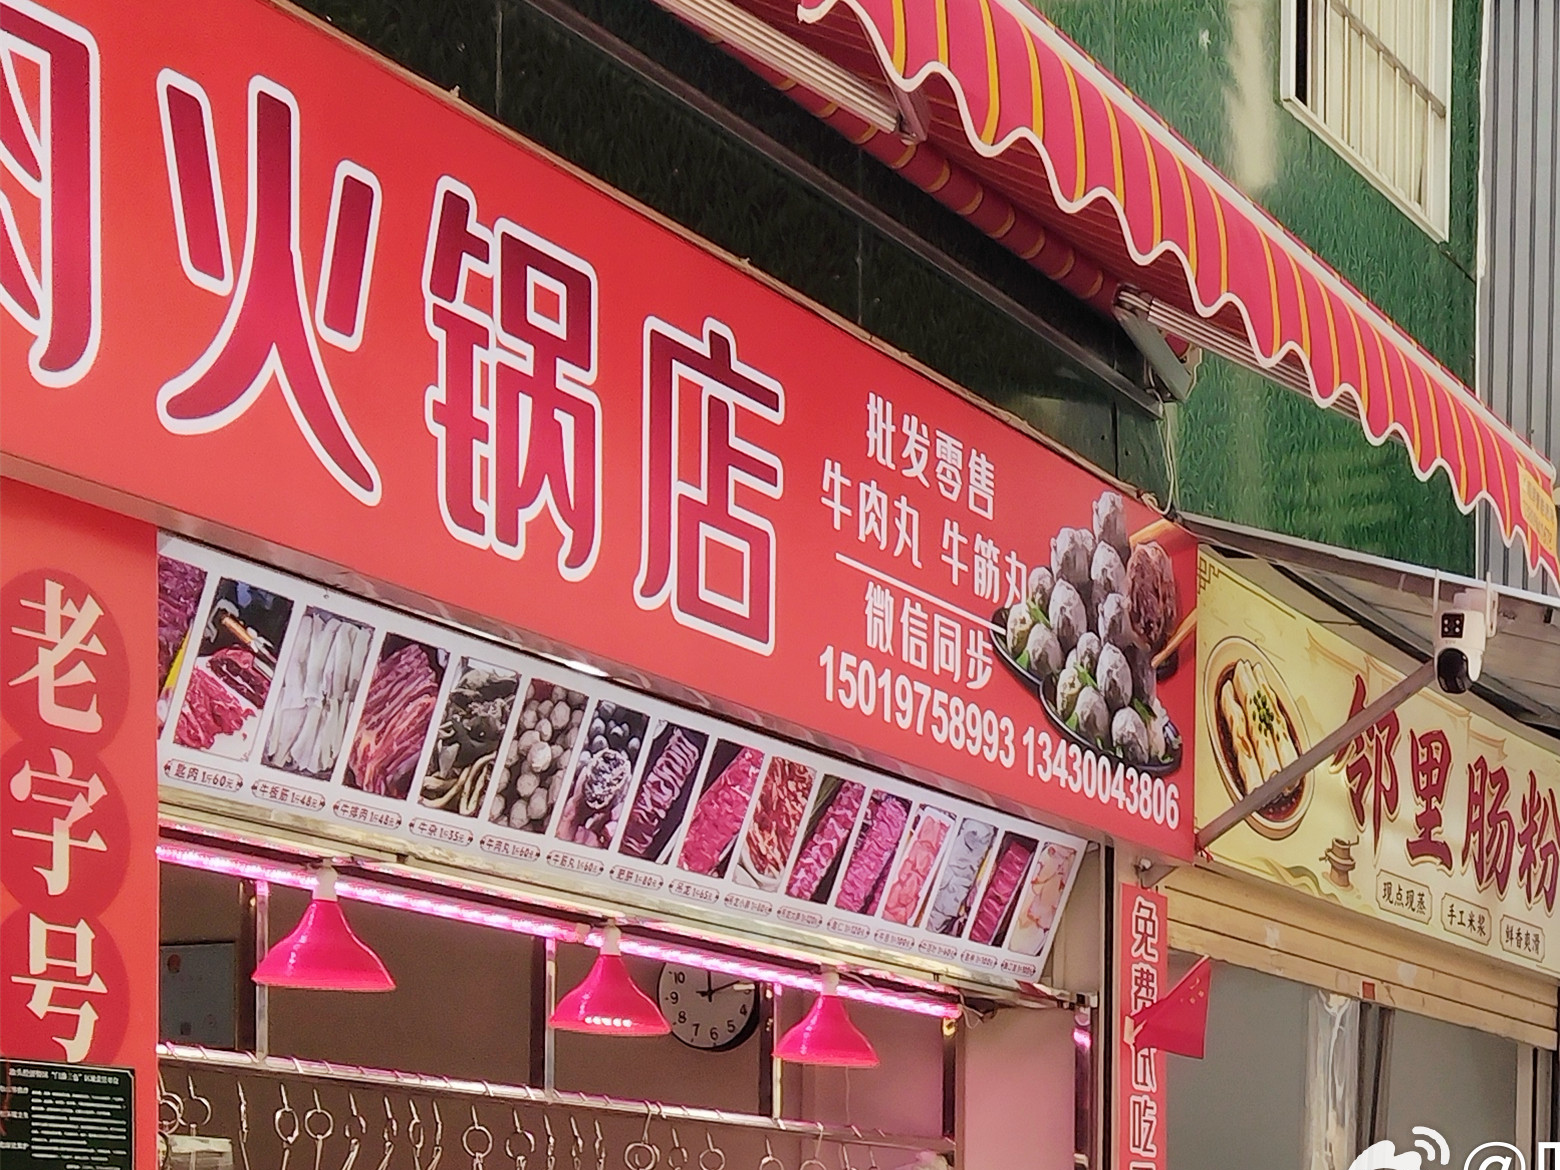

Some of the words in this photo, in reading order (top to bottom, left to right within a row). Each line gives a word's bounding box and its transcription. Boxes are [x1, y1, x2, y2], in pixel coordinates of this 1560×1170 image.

[867, 391, 995, 521] 批发零售
[821, 458, 922, 568] 牛肉丸
[941, 517, 1028, 611] 牛筋丸
[865, 581, 993, 690] 微信同步
[819, 645, 1015, 768] 15019758993
[1022, 726, 1180, 830] 13430043806
[8, 578, 109, 1064] 老字号
[1382, 881, 1427, 916] 现点现蒸
[1447, 903, 1487, 938] 手工米浆
[1505, 923, 1542, 956] 鲜香爽滑
